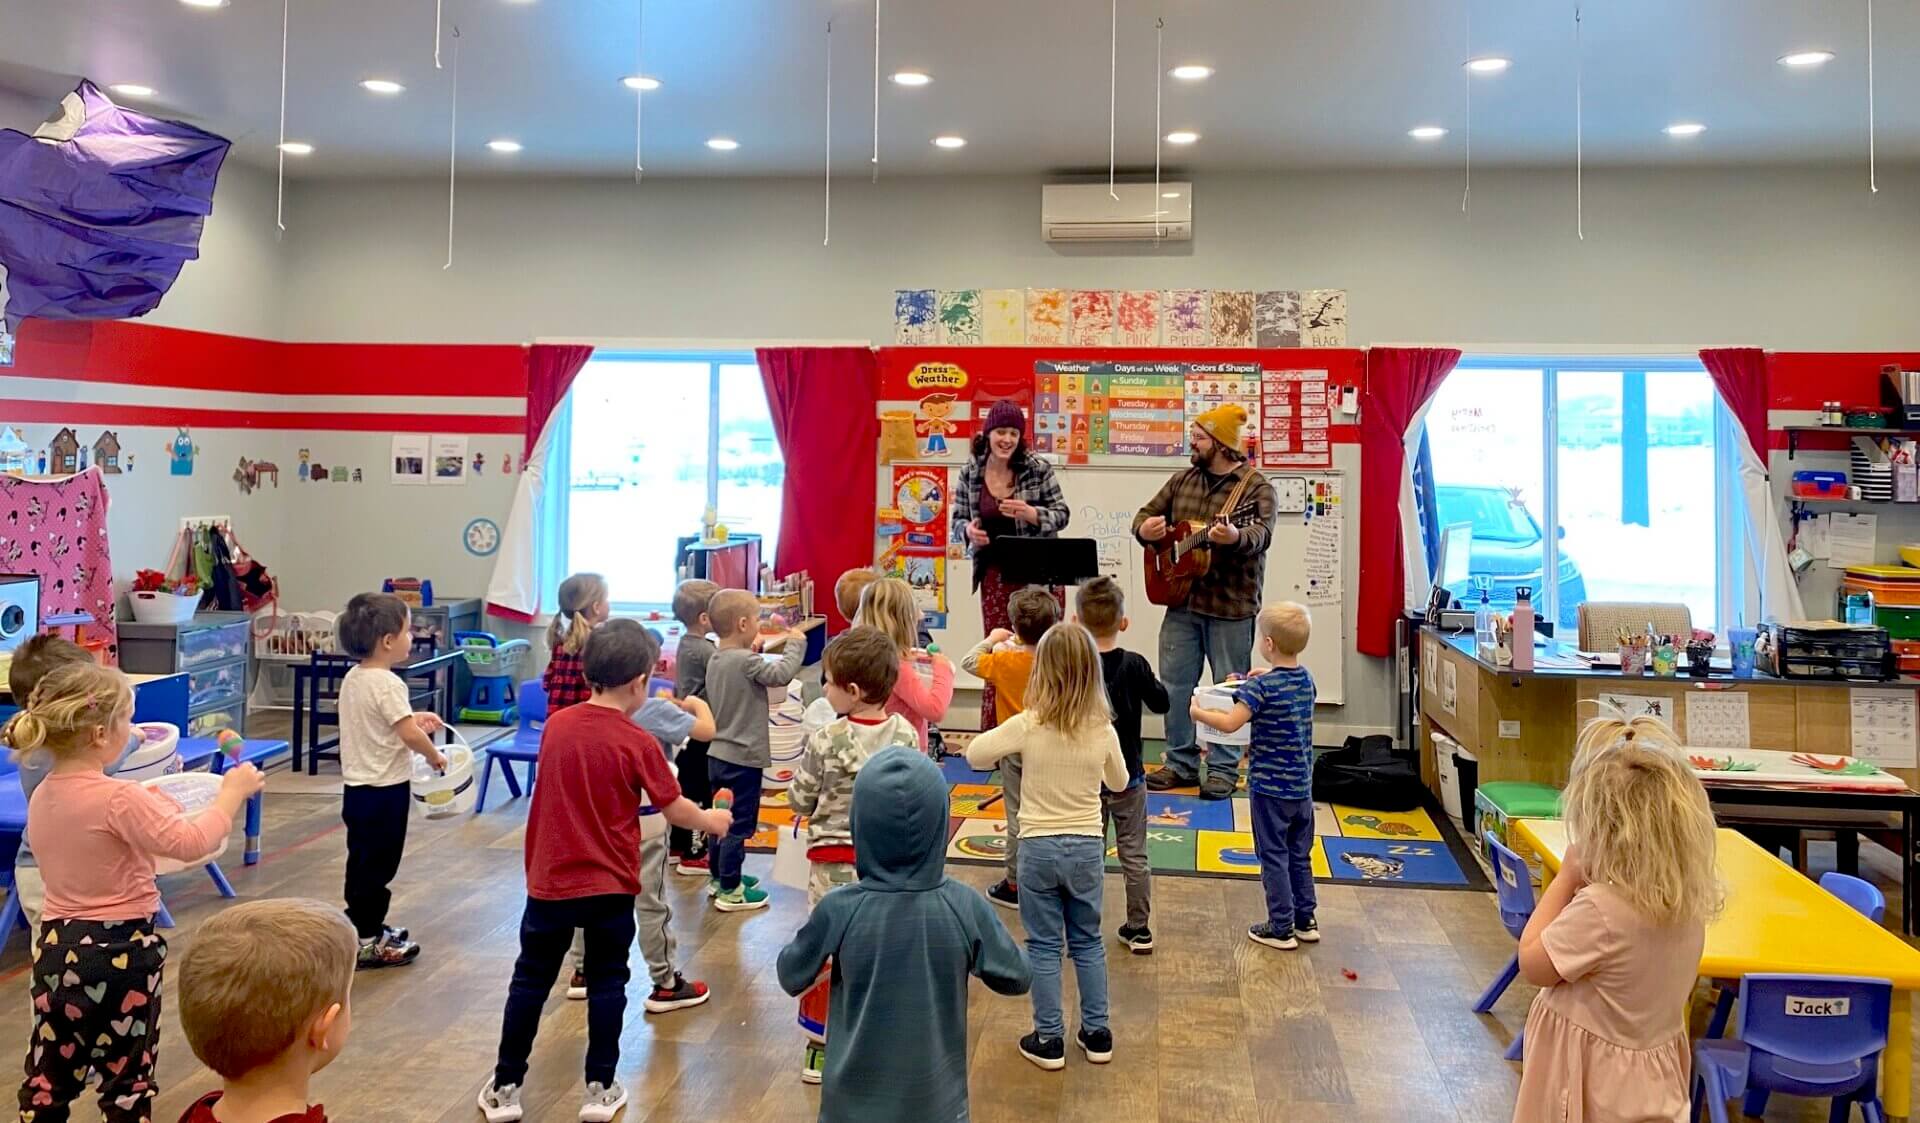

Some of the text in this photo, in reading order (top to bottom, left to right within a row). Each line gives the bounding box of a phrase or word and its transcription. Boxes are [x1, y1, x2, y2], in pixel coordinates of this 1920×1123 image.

[1125, 333, 1151, 345] PINK
[921, 366, 948, 374] Dress
[1054, 364, 1090, 373] Weather
[1114, 364, 1136, 374] Days
[1155, 364, 1180, 373] Week
[1191, 364, 1217, 373] Colors
[1225, 364, 1255, 373] Shapes
[914, 374, 960, 385] Weather
[1118, 377, 1148, 386] Sunday
[1118, 400, 1149, 409] Tuesday
[1115, 422, 1150, 432] Thursday
[1120, 433, 1145, 442] Friday
[1115, 445, 1150, 454] Saturday
[1792, 1000, 1832, 1015] Jack
